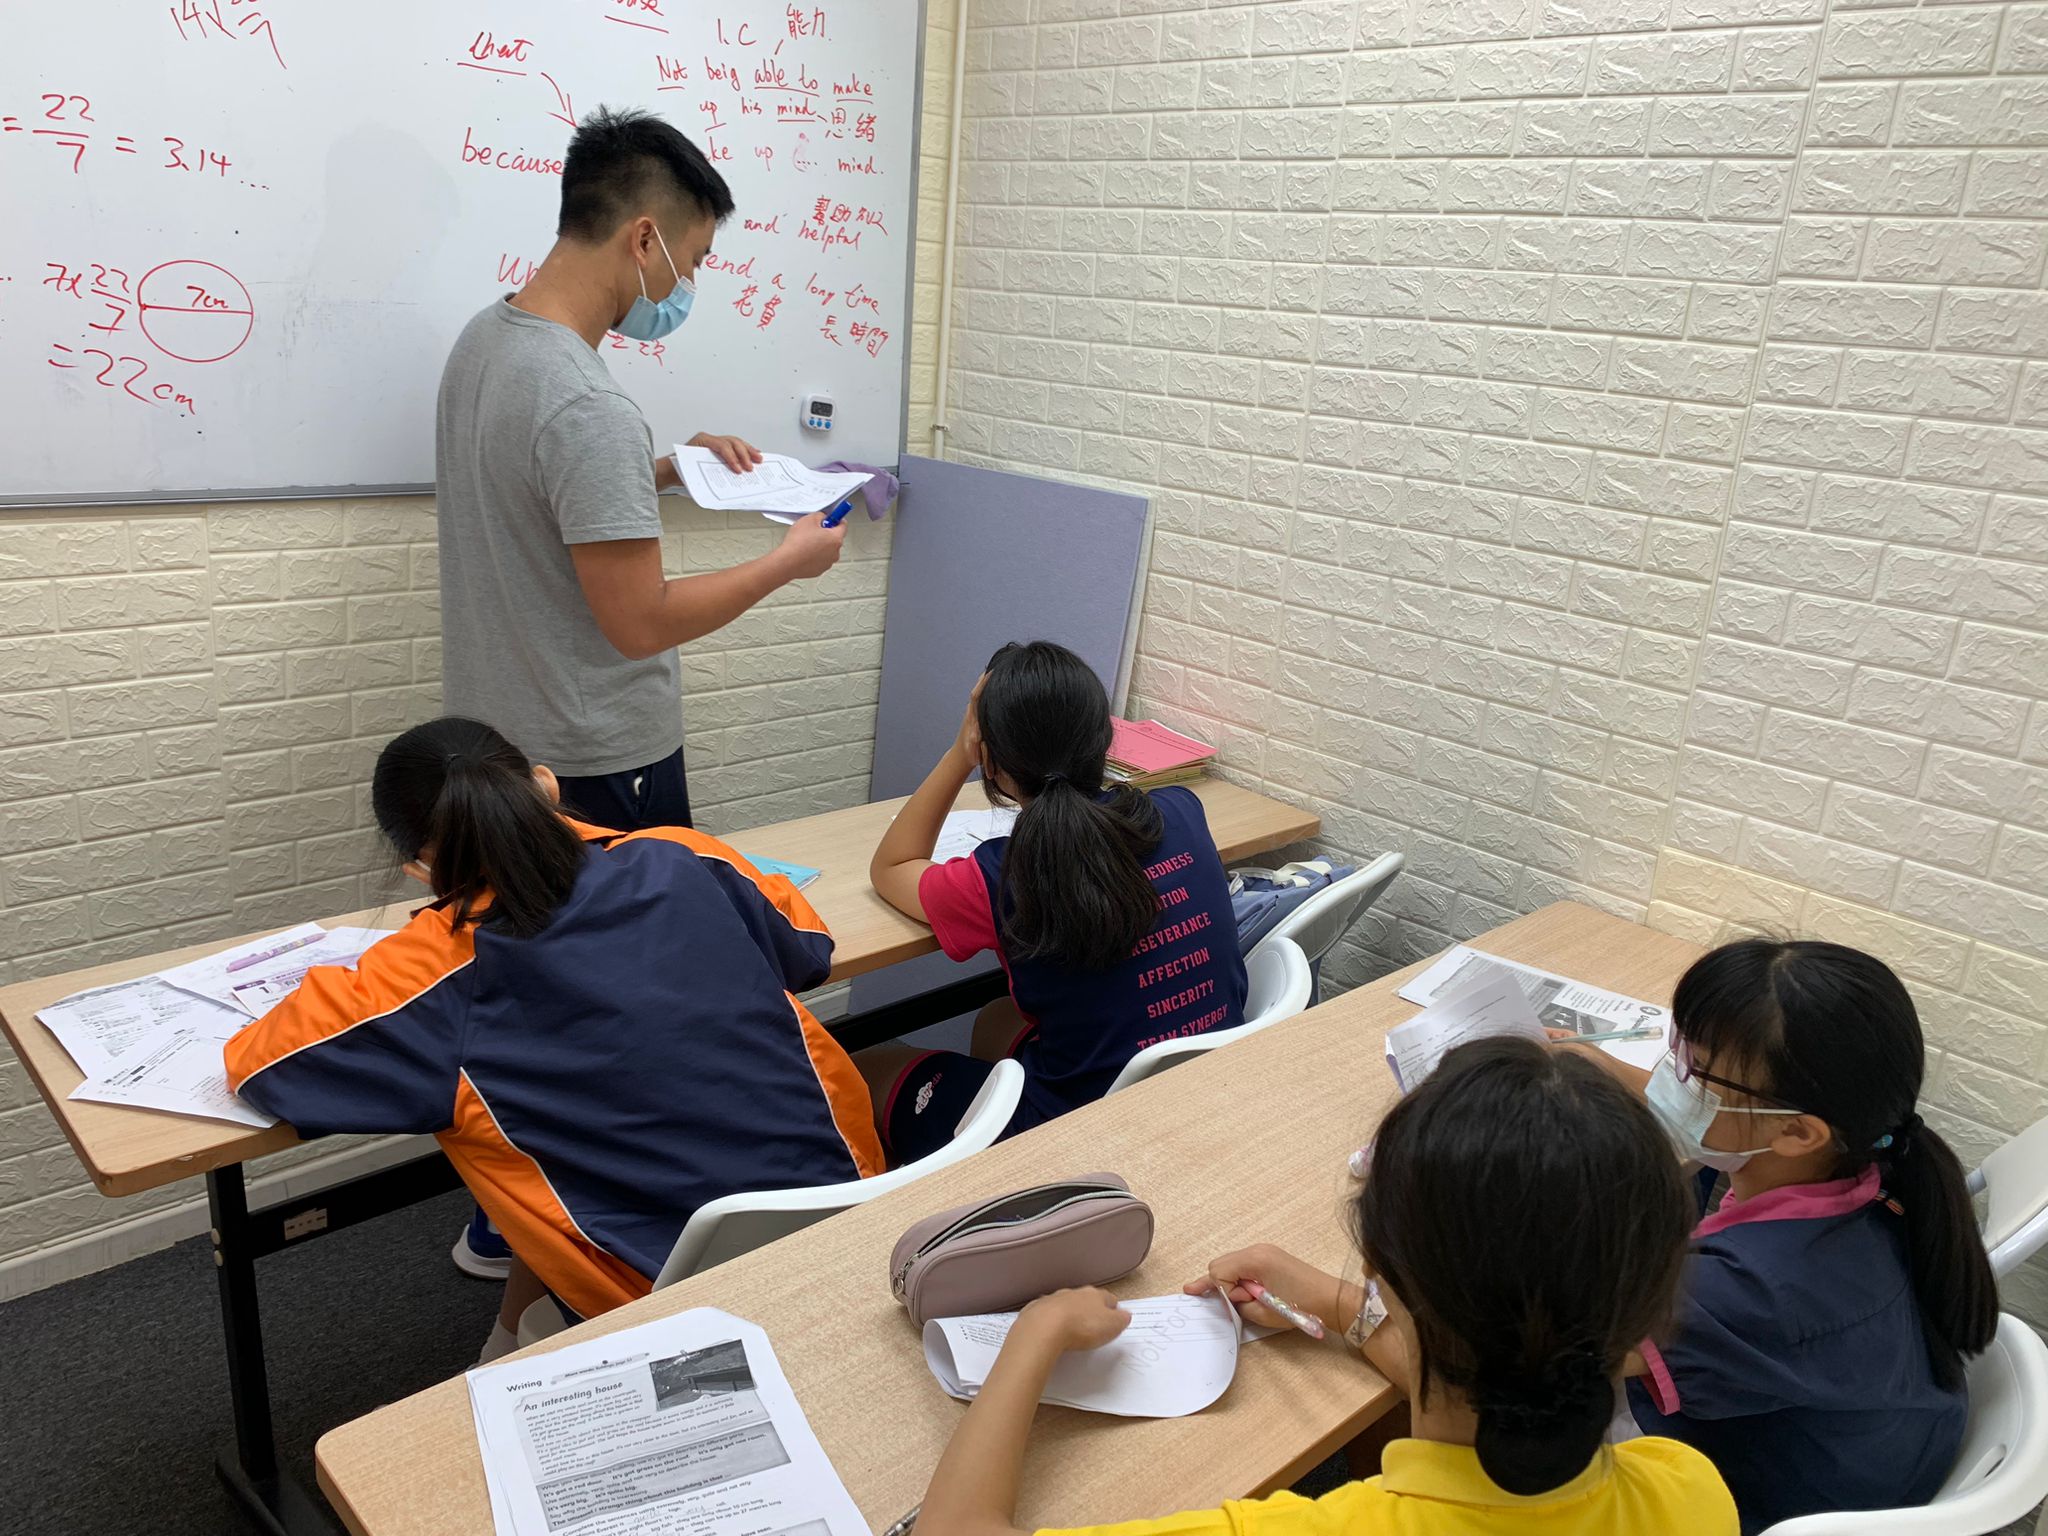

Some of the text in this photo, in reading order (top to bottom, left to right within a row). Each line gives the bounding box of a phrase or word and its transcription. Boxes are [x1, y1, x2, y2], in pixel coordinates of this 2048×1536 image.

[656, 54, 688, 82] Not
[754, 58, 789, 88] able
[797, 63, 819, 90] to
[833, 73, 873, 96] make
[41, 93, 95, 122] 22
[699, 99, 718, 126] up
[56, 141, 86, 174] 7
[744, 215, 780, 234] and
[704, 254, 755, 279] end
[1137, 946, 1211, 989] AFFECTION
[1146, 979, 1215, 1019] SINCERITY
[1181, 1003, 1229, 1038] SYNERGY
[506, 1380, 542, 1392] Writing
[523, 1382, 623, 1412] An interesting house
